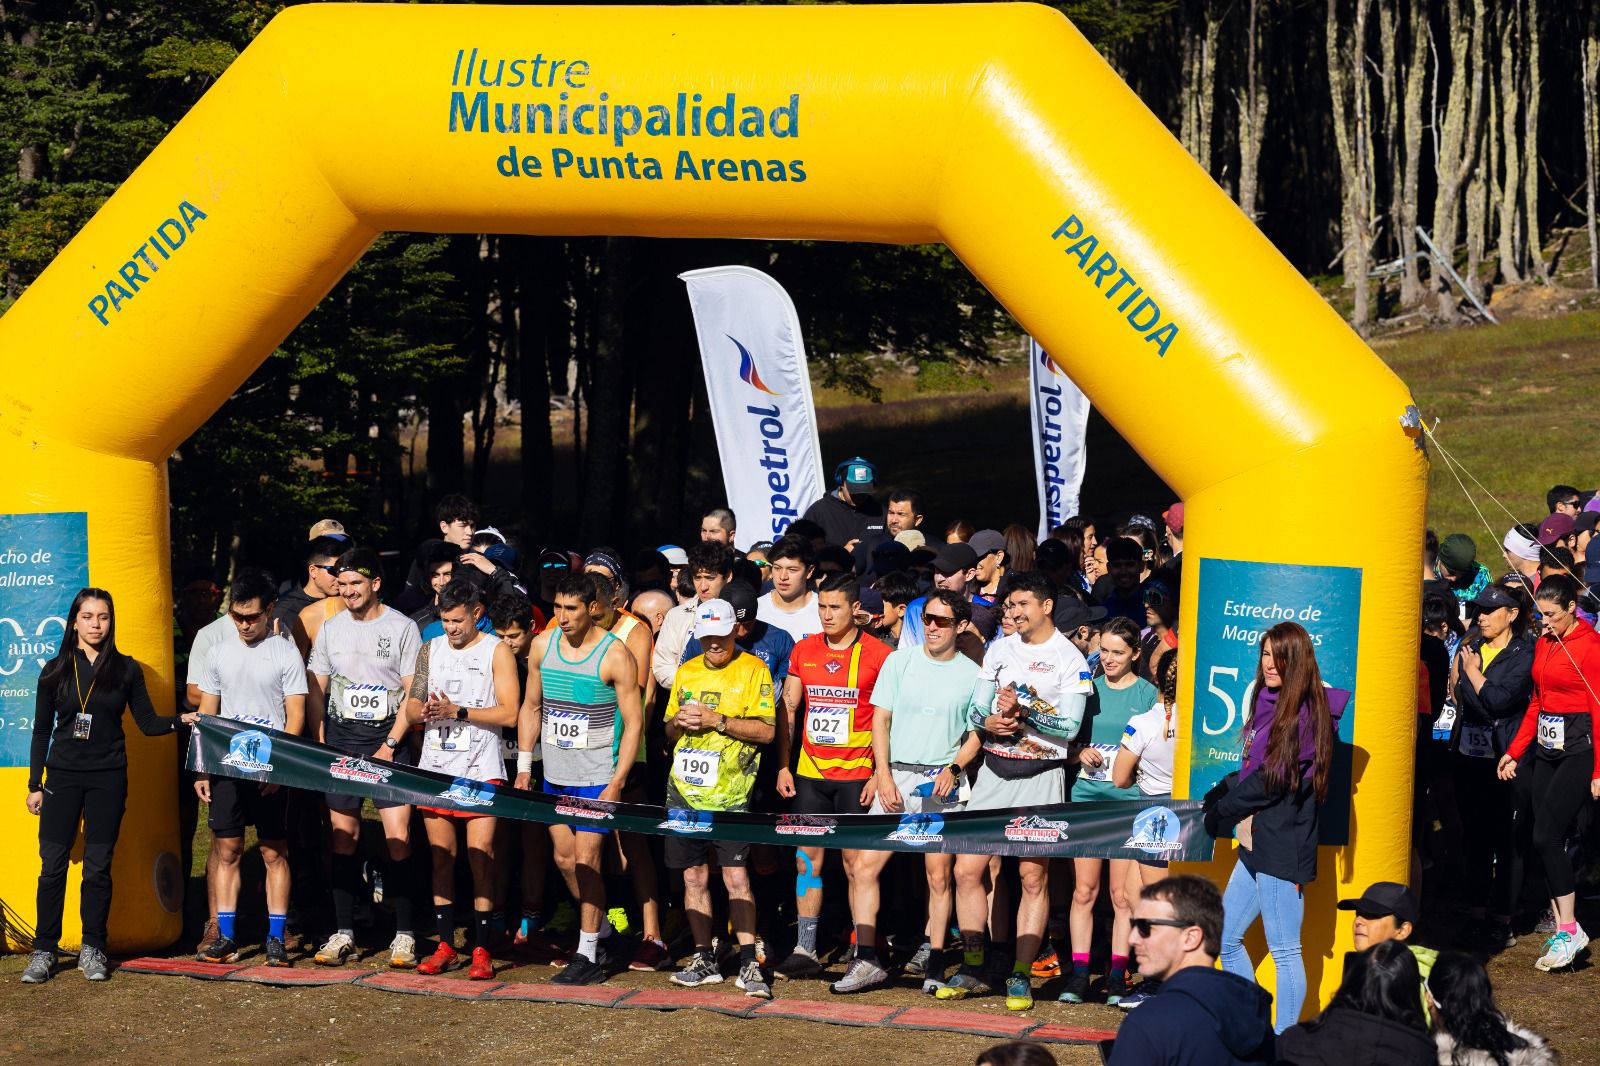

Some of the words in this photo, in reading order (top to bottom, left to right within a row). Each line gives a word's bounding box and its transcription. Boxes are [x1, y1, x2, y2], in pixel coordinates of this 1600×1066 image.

[452, 48, 590, 88] Ilustre
[449, 91, 800, 147] Municipalidad
[496, 146, 542, 178] de
[552, 148, 663, 180] Punta
[674, 150, 807, 183] Arenas
[88, 200, 208, 326] PARTIDA
[1051, 214, 1179, 357] PARTIDA
[31, 549, 51, 564] de
[1224, 600, 1295, 620] Estrecho
[1299, 605, 1322, 621] de
[8, 637, 56, 657] años
[809, 687, 855, 698] HITACHI
[351, 695, 379, 708] 096
[437, 725, 463, 740] 119
[553, 722, 579, 737] 108
[813, 718, 840, 733] 027
[1468, 732, 1488, 747] 153
[1208, 747, 1240, 762] Punta
[682, 758, 710, 775] 190
[555, 805, 607, 817] INDOMITO
[1005, 828, 1060, 837] INDOMITO
